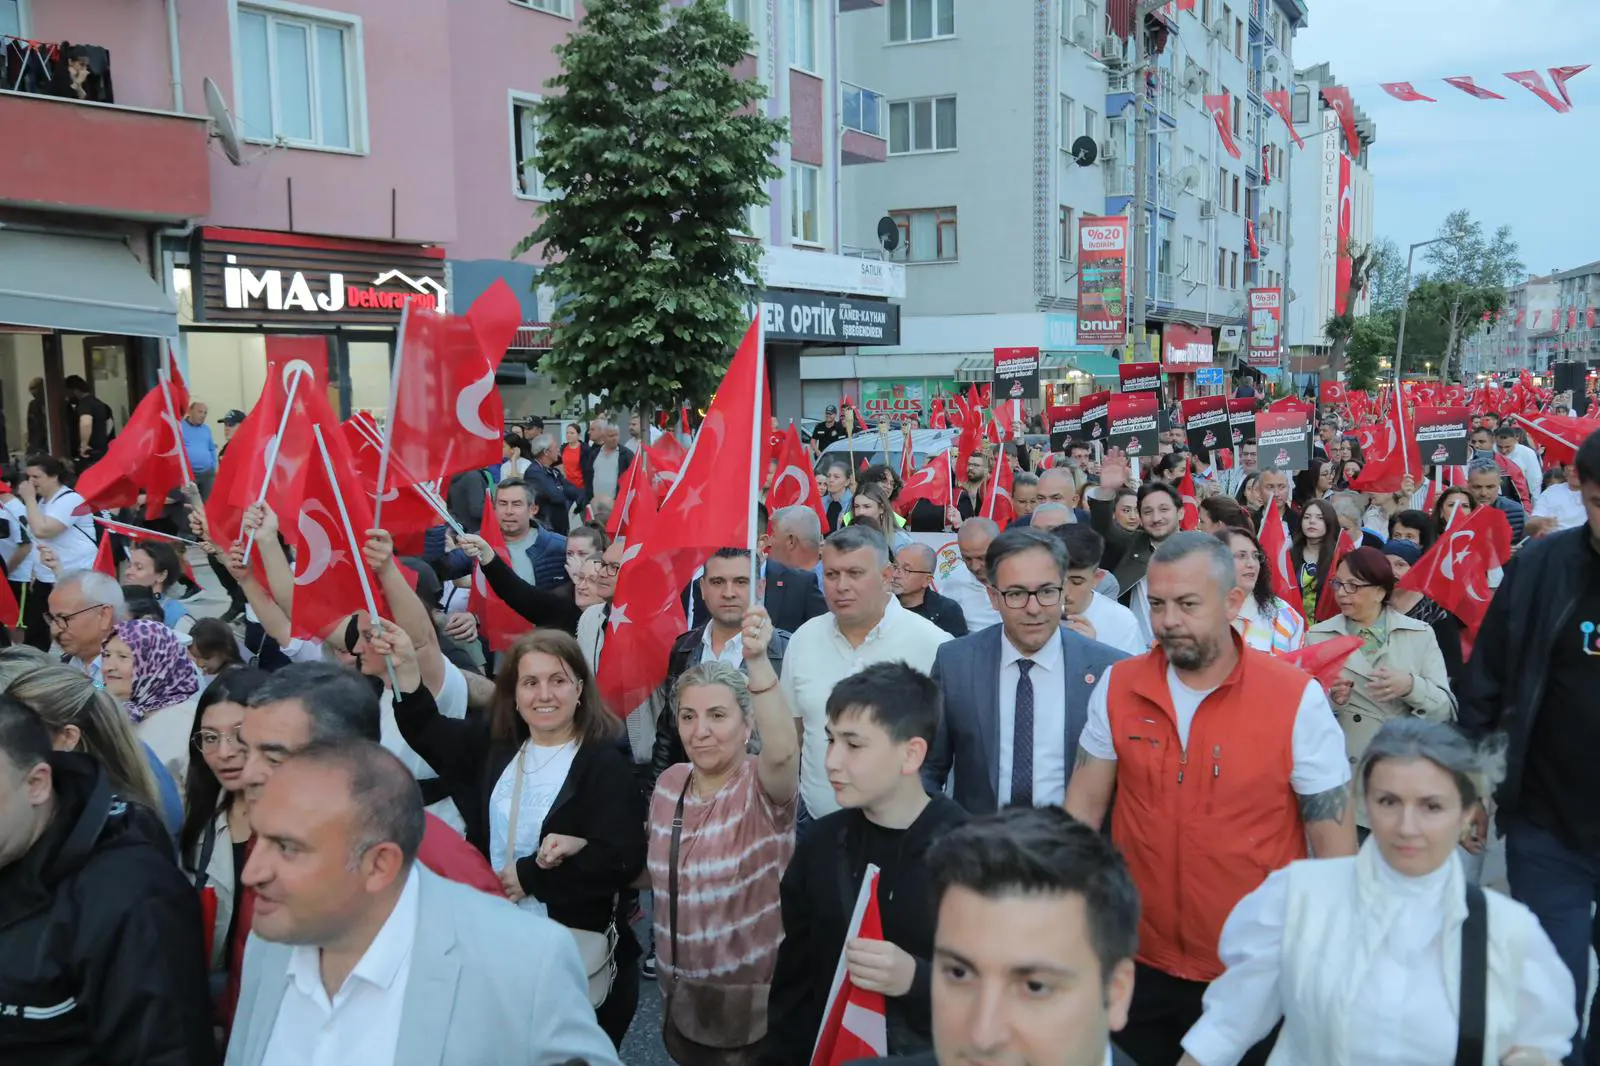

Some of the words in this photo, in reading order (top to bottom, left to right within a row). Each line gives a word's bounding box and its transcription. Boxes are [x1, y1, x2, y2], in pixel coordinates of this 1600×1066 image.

[1088, 228, 1120, 240] %20
[224, 254, 344, 312] İMAJ
[740, 301, 785, 333] AER
[790, 300, 836, 336] OPTİK
[839, 308, 886, 324] KANER-KAYHAN
[1080, 319, 1122, 331] onur
[1250, 350, 1277, 358] onur
[865, 398, 922, 411] ULUS
